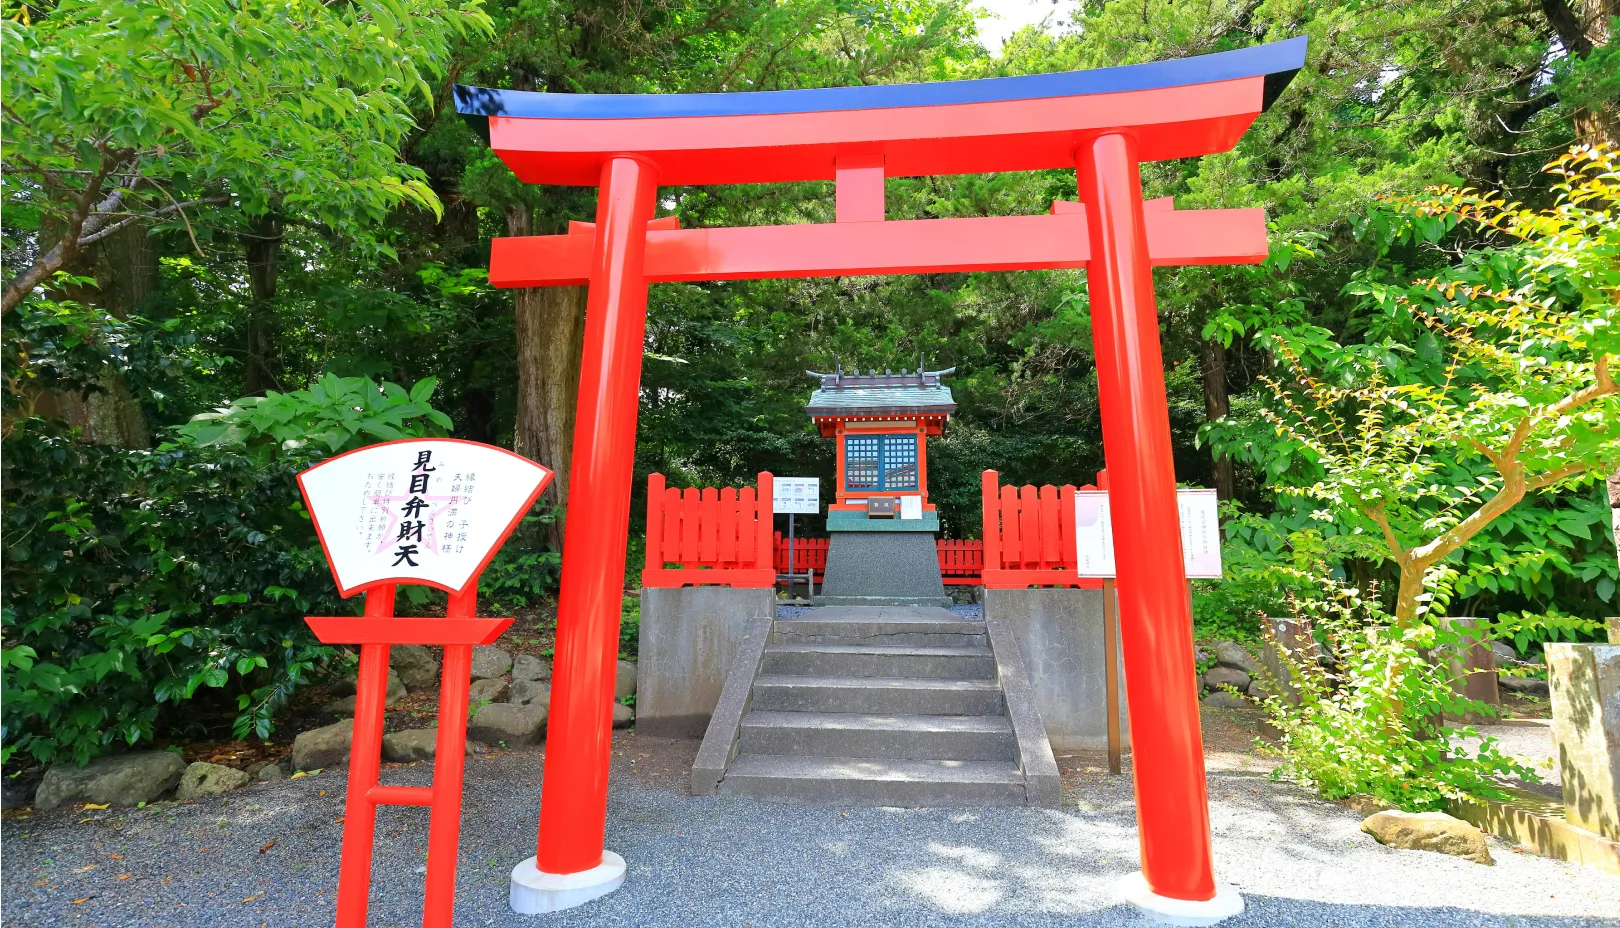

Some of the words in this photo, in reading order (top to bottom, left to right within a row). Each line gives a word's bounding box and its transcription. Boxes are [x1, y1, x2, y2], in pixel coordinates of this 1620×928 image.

[391, 450, 436, 567] 見目弁財天
[441, 472, 462, 553] 夫婦円満の神様
[463, 473, 476, 505] 縁結び
[456, 520, 469, 553] 子授け
